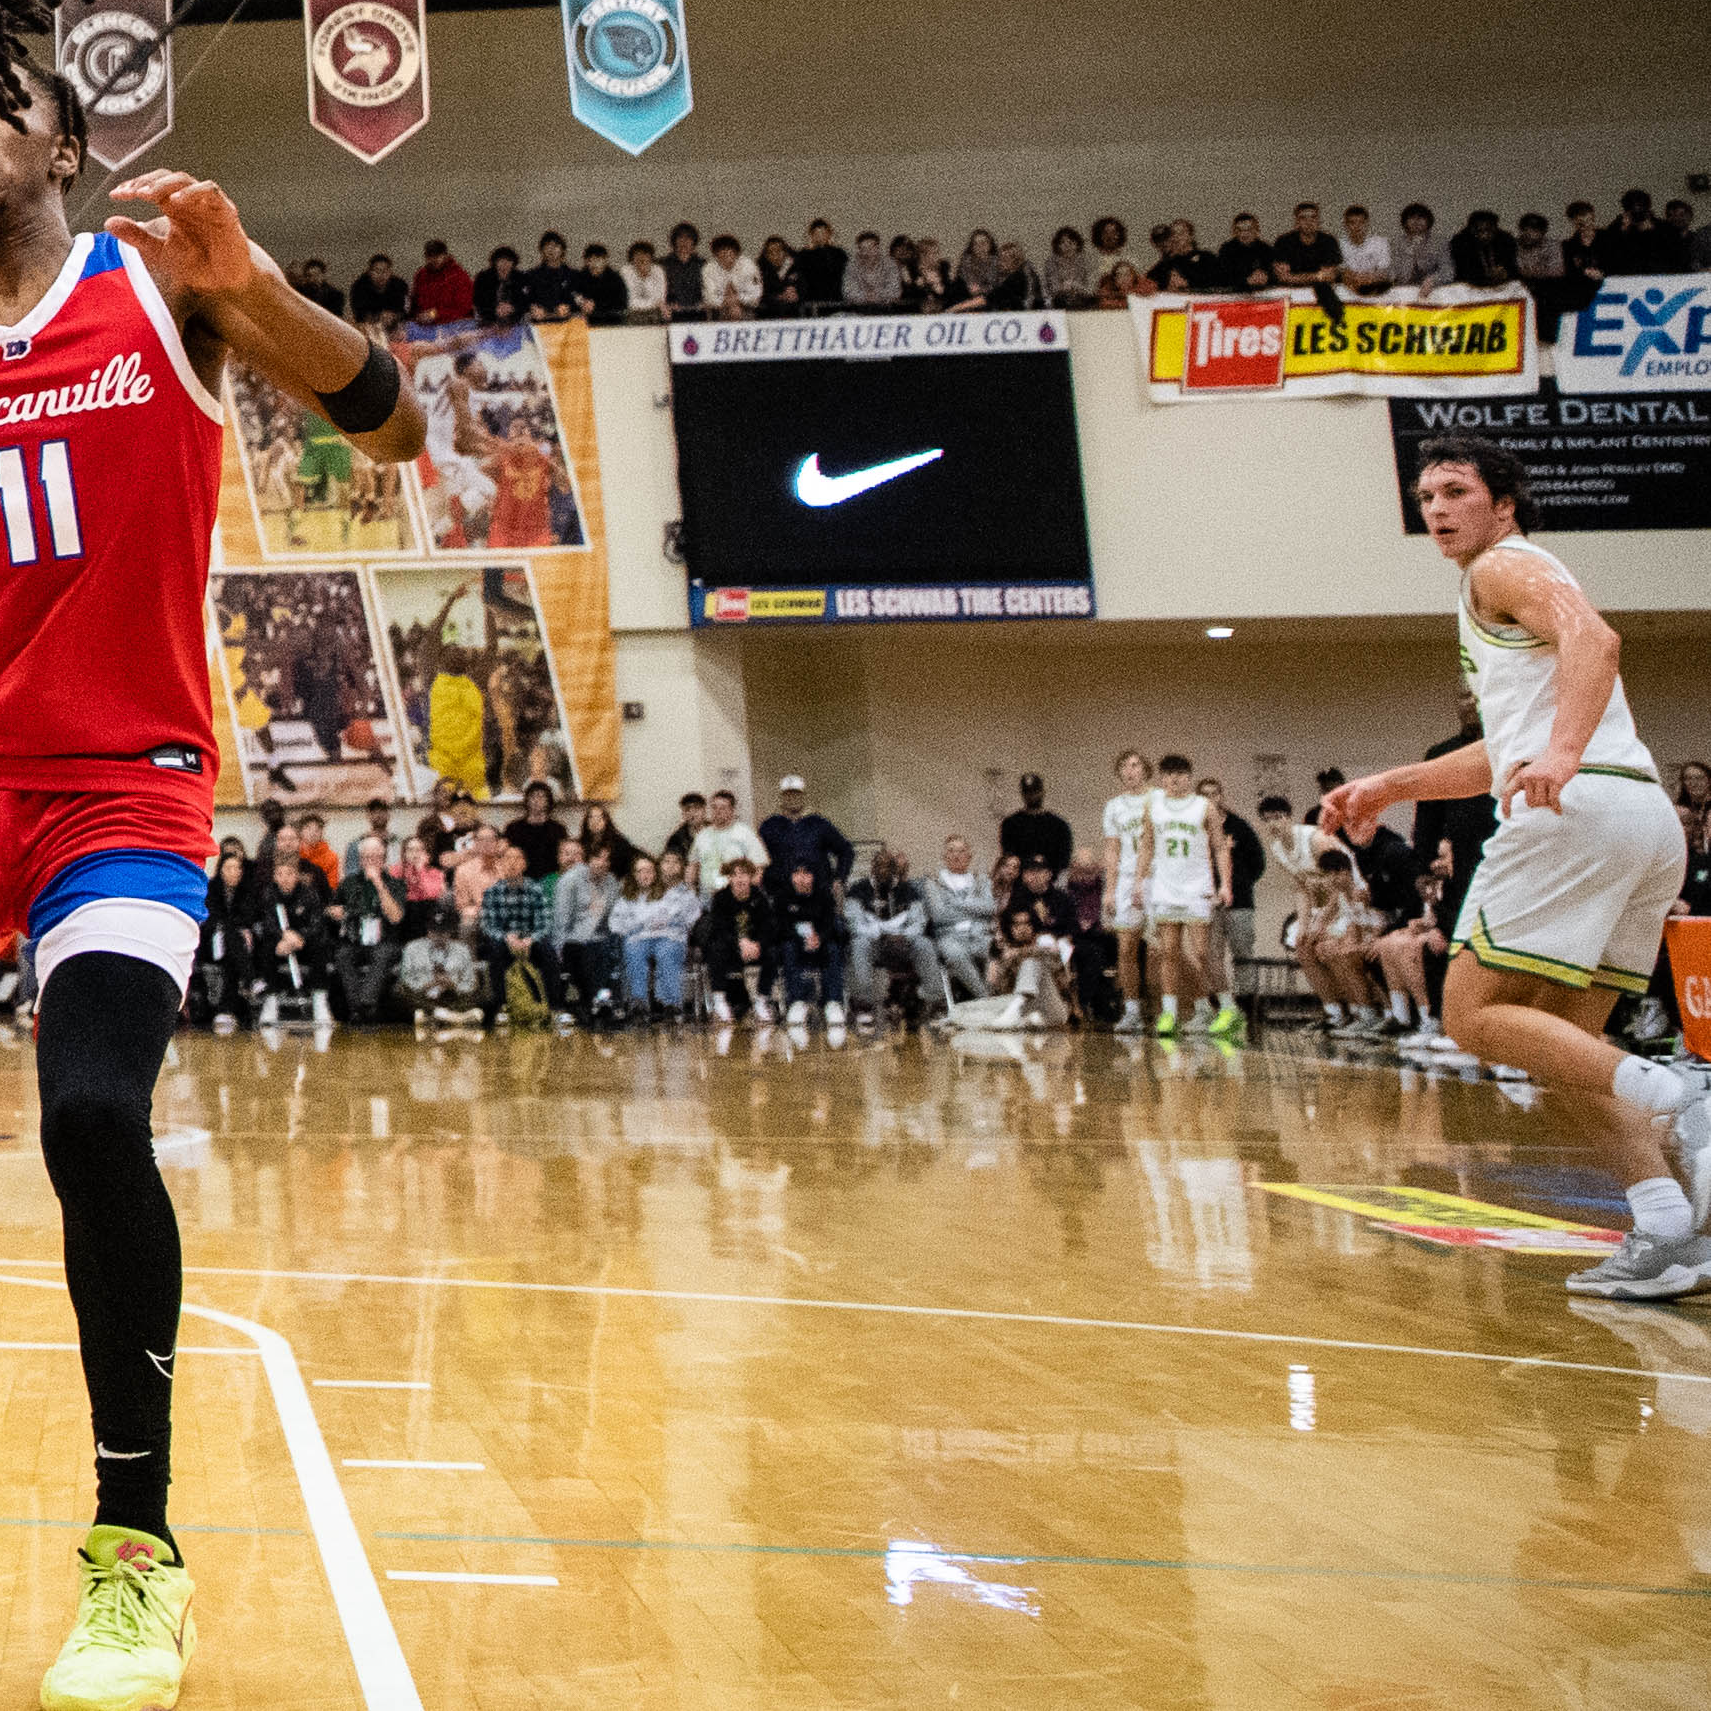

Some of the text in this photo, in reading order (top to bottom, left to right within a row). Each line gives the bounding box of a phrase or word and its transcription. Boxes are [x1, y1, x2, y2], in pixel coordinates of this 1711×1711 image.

[712, 319, 1031, 355] BRETTHAUER OIL CO.
[1193, 311, 1508, 367] Tires LES SCHWAB
[1417, 398, 1709, 429] WOLFE DENTAL
[871, 588, 956, 615] SCHWAB
[1004, 586, 1092, 614] CENTERS
